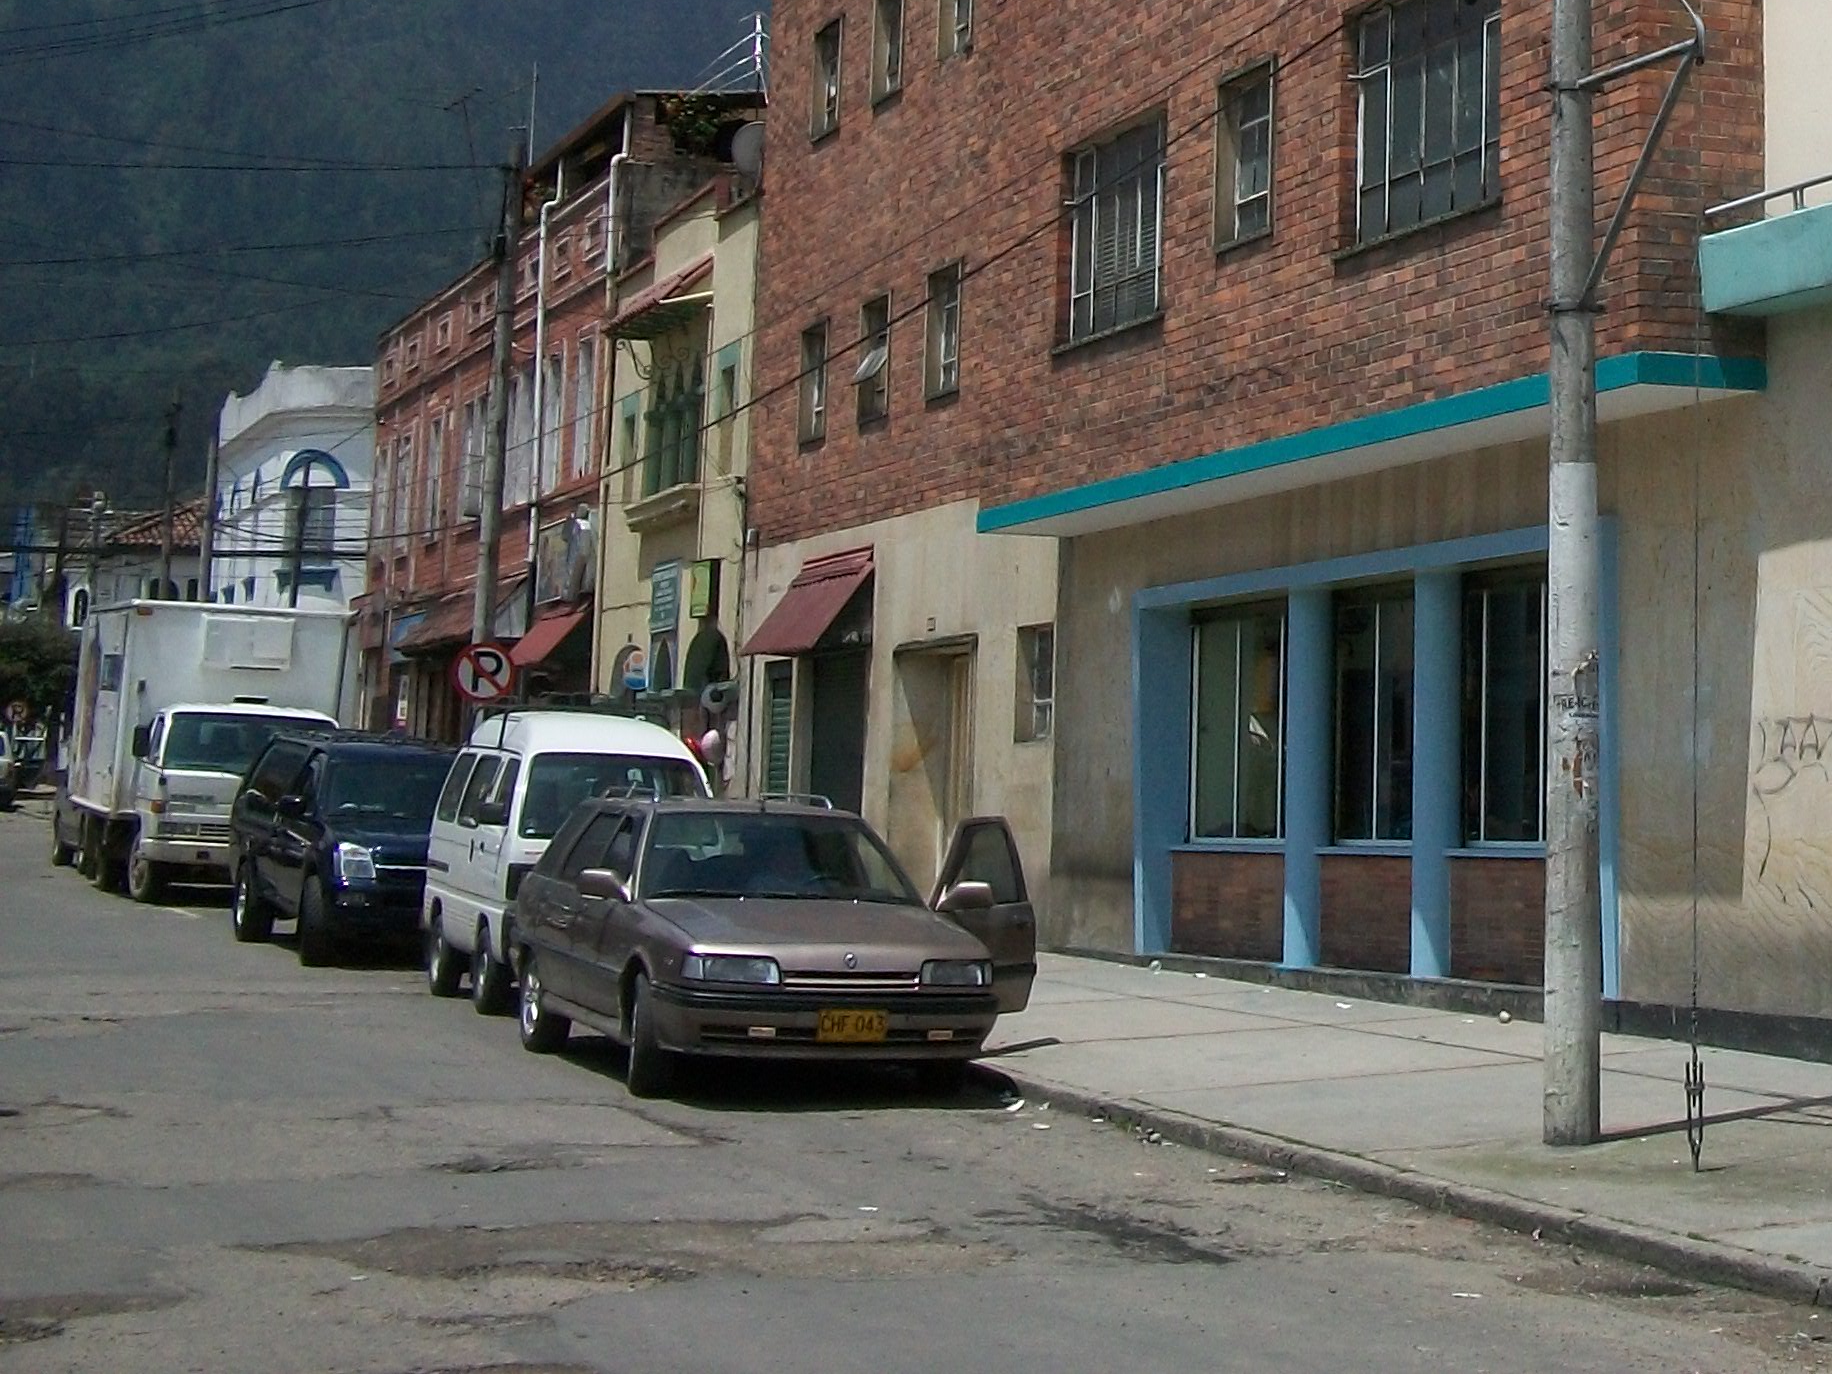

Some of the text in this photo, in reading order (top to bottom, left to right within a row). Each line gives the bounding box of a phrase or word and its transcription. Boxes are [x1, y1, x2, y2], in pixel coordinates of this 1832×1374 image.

[471, 651, 503, 693] P
[821, 1014, 886, 1033] CHF 043
